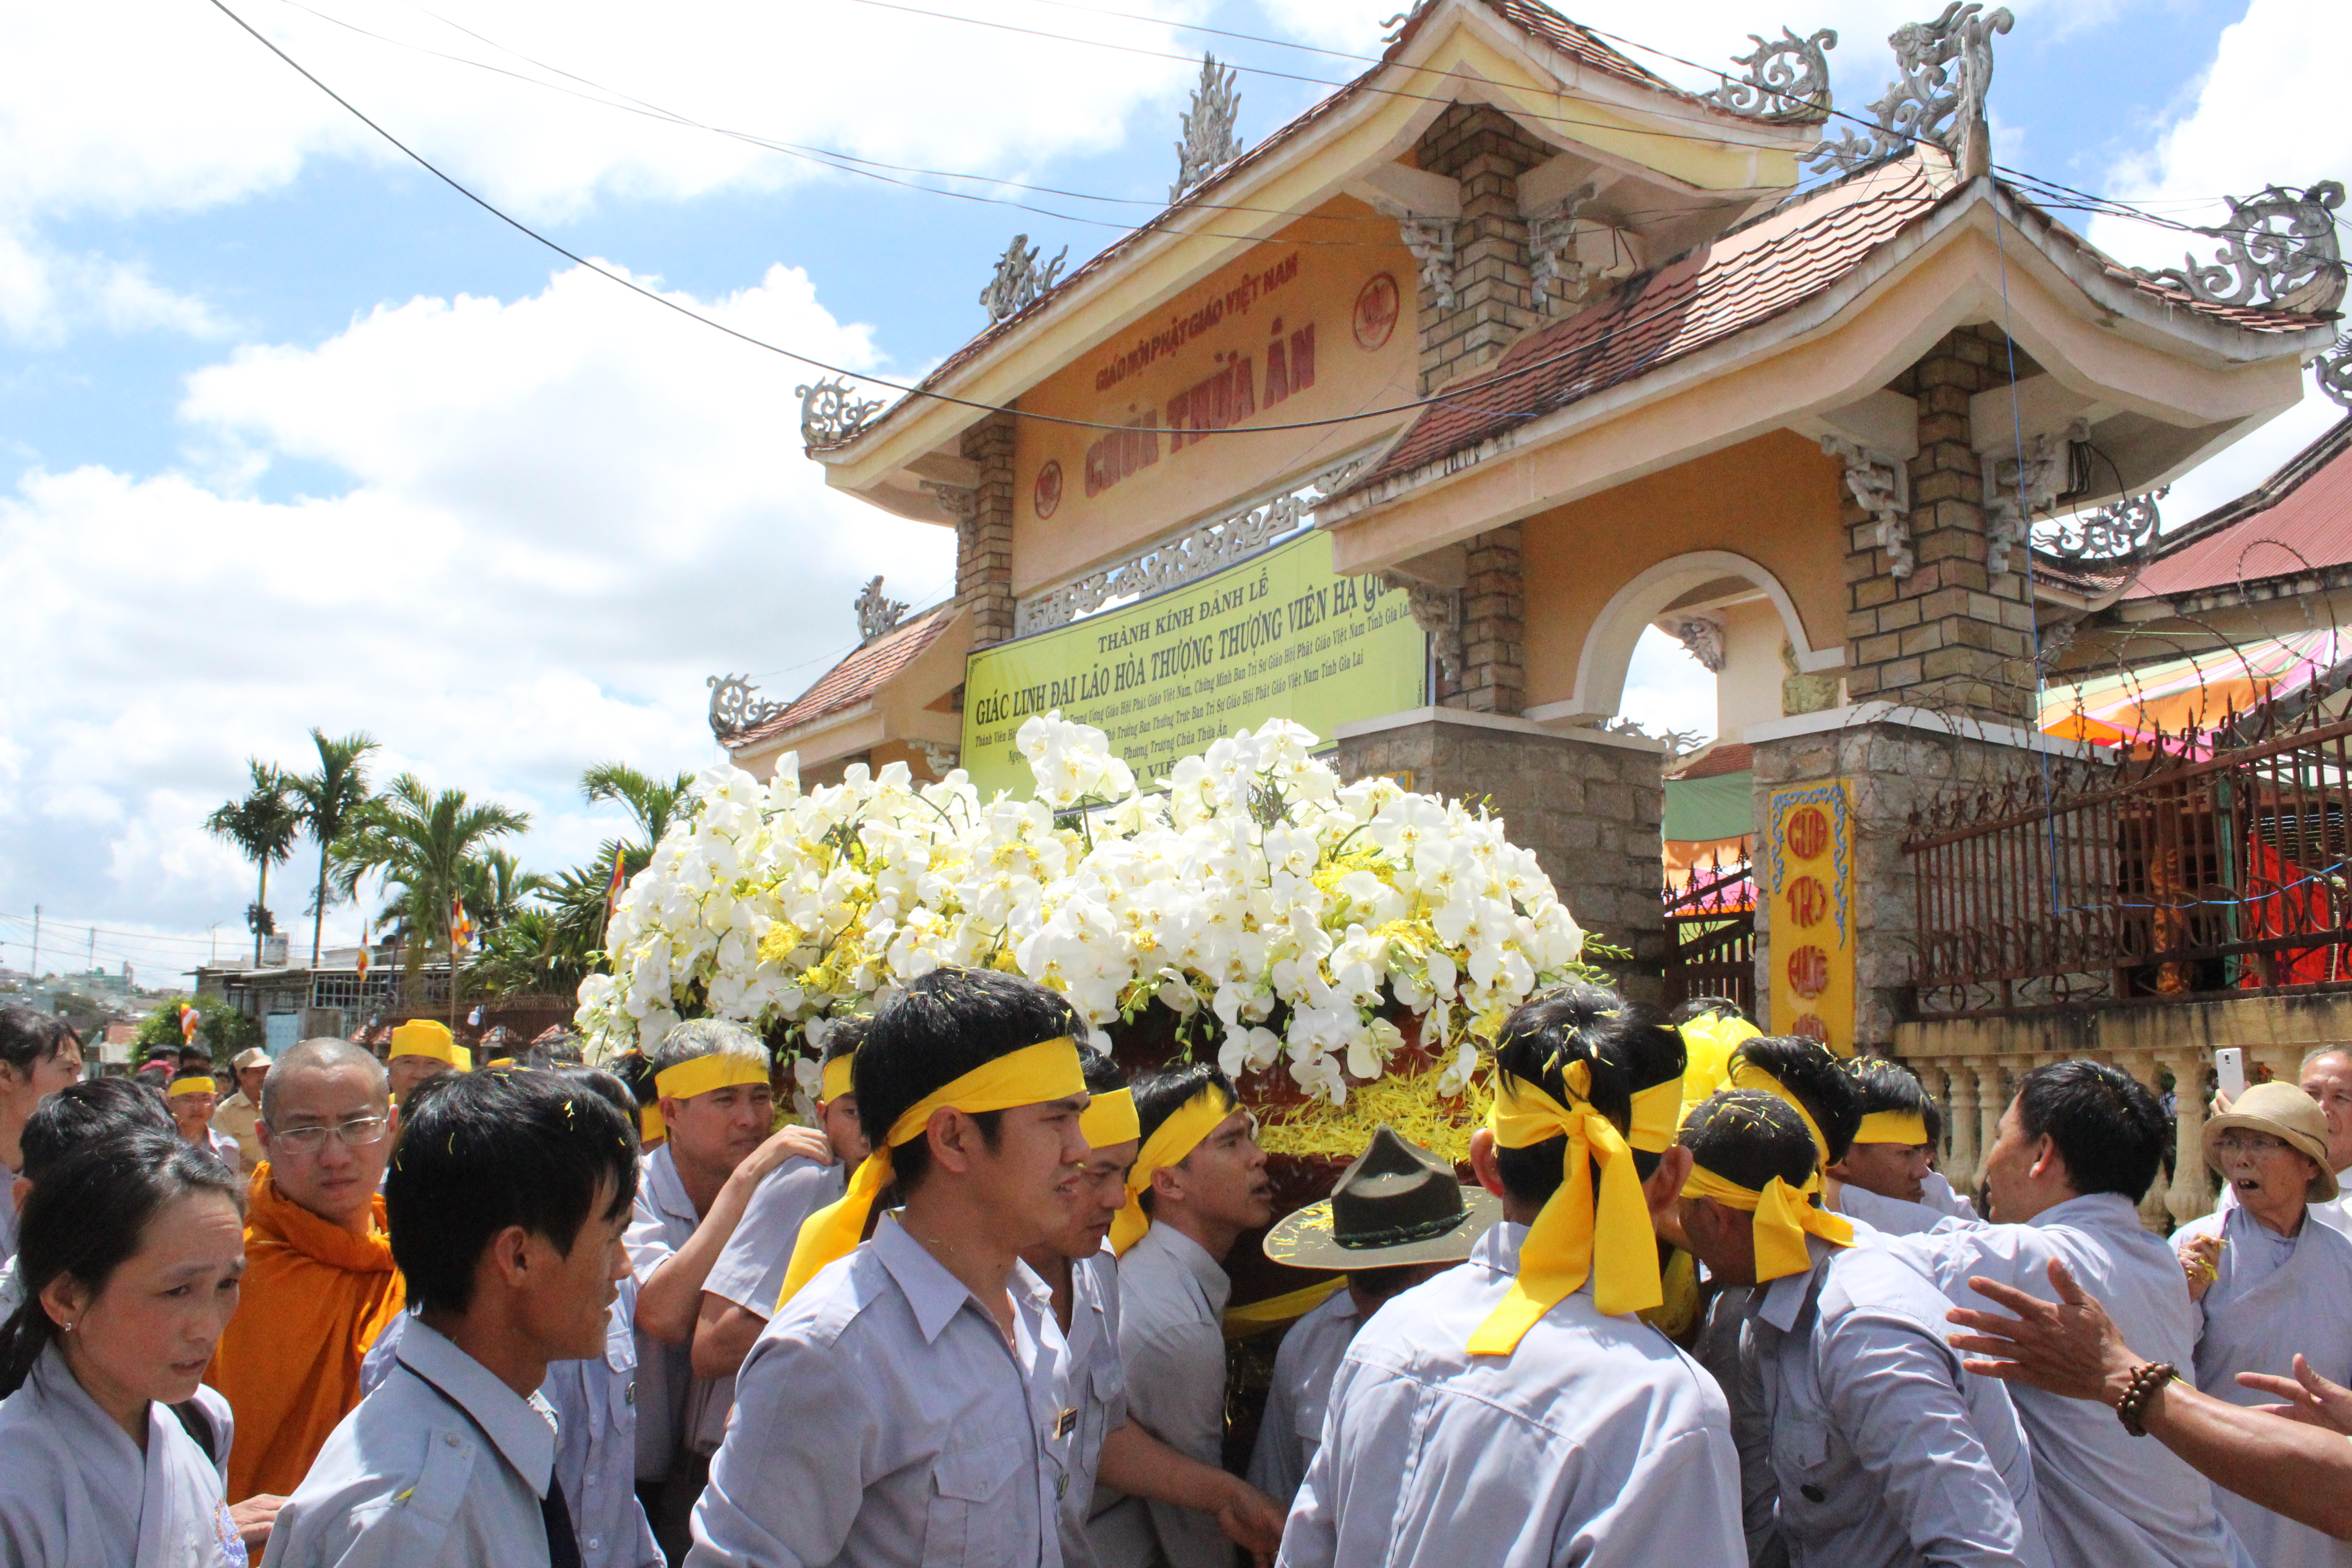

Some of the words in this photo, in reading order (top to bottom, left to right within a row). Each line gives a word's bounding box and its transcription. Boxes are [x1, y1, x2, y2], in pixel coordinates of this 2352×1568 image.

[1096, 353, 1126, 392] GIÁO
[1151, 317, 1188, 361] PHẬT
[1188, 296, 1223, 339] GIÁO
[1226, 273, 1261, 315] VIỆT
[1264, 251, 1298, 295] NAM
[976, 689, 1009, 725] GIÁC
[1013, 684, 1047, 716] LINH
[1049, 676, 1077, 712] ĐẠI
[1080, 663, 1109, 701] LÃO
[1114, 652, 1146, 692] HÒA
[1151, 635, 1213, 681] THƯỢNG
[1218, 608, 1282, 660] THƯỢNG
[1288, 584, 1328, 633] VIÊN
[1333, 577, 1357, 618] HẠ
[1098, 622, 1150, 653] THÀNH
[1155, 606, 1194, 636] KÍNH
[1199, 587, 1244, 621] ĐẢNH
[1249, 567, 1269, 602] LỄ
[1089, 707, 1104, 724] Ương
[1106, 704, 1119, 718] Giáo
[1121, 700, 1131, 716] Hội
[1133, 697, 1146, 713] Phật
[1148, 691, 1161, 707] Giáo
[1163, 686, 1175, 704] Việt
[1176, 685, 1192, 699] Nam,
[1195, 676, 1215, 694] Chứng
[1216, 670, 1232, 687] Minh
[1234, 668, 1245, 682] Ban
[1248, 660, 1257, 678] Trị
[1259, 658, 1267, 675] Sự
[1268, 651, 1282, 670] Giáo
[1284, 645, 1295, 665] Hội
[1297, 640, 1313, 659] Phật
[1315, 633, 1331, 652] Giáo
[1333, 626, 1348, 647] Việt
[1349, 622, 1365, 639] Nam
[1367, 611, 1383, 632] Tỉnh
[1386, 606, 1397, 624] Gia
[1139, 720, 1150, 733] Ban
[1153, 713, 1174, 729] Thường
[1176, 707, 1190, 725] Trực
[1192, 706, 1203, 720] Ban
[1206, 700, 1215, 717] Trị
[1216, 698, 1225, 715] Sự
[1226, 694, 1240, 710] Giáo
[1243, 688, 1253, 706] Hội
[1255, 684, 1269, 701] Phật
[1272, 678, 1286, 696] Giáo
[1288, 670, 1301, 691] Việt
[1303, 669, 1318, 684] Nam
[1321, 659, 1337, 678] Tỉnh
[1339, 654, 1350, 672] Gia
[1352, 647, 1363, 667] Lai
[976, 732, 992, 747] Thành
[994, 730, 1006, 743] Viên
[1123, 744, 1148, 760] Phương
[1151, 737, 1174, 754] Trượng
[1176, 730, 1195, 746] Chùa
[1198, 725, 1215, 742] Thừa
[1217, 719, 1227, 737] Ân
